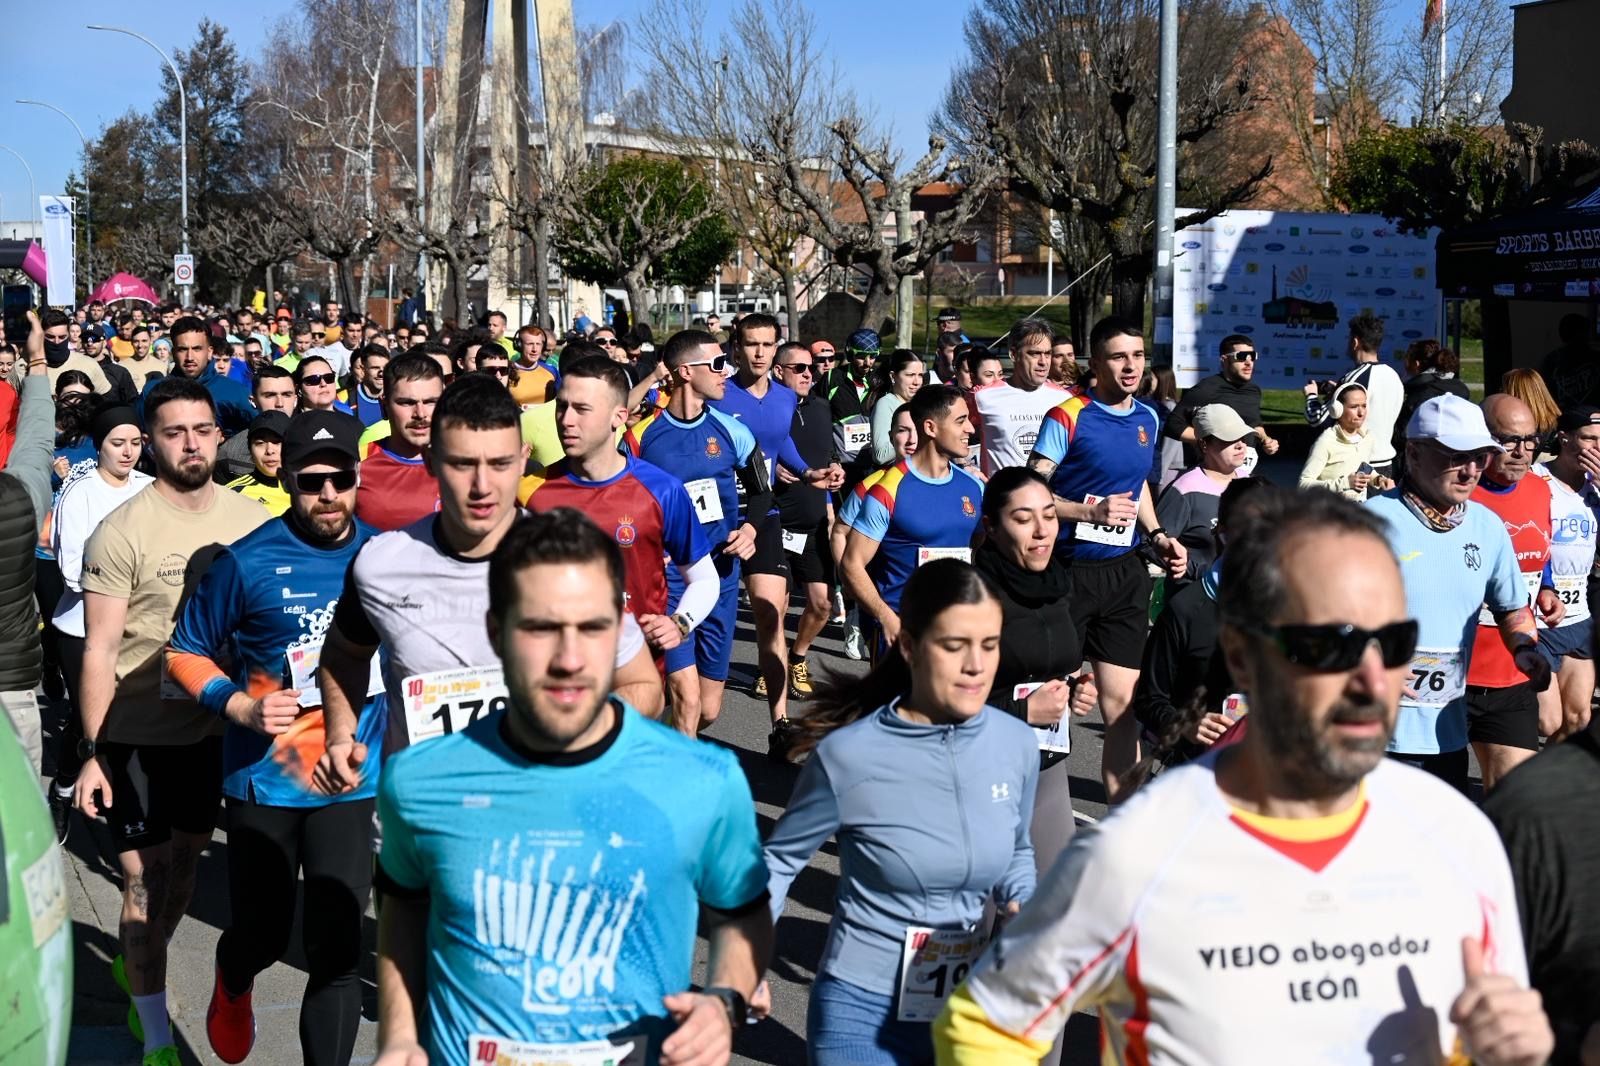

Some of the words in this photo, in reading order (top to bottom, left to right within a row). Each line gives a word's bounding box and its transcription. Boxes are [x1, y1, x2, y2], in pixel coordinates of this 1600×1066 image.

[1496, 234, 1549, 254] SPORTS
[851, 433, 871, 443] 528
[782, 530, 794, 542] 5
[1515, 551, 1542, 561] orre
[408, 679, 423, 697] 10
[1412, 669, 1445, 692] 76
[1227, 698, 1238, 710] 10
[912, 932, 930, 951] 10
[1199, 943, 1280, 969] VIEJO
[1291, 934, 1429, 966] abogados
[1289, 972, 1358, 1002] LEÓN
[478, 1041, 497, 1063] 10
